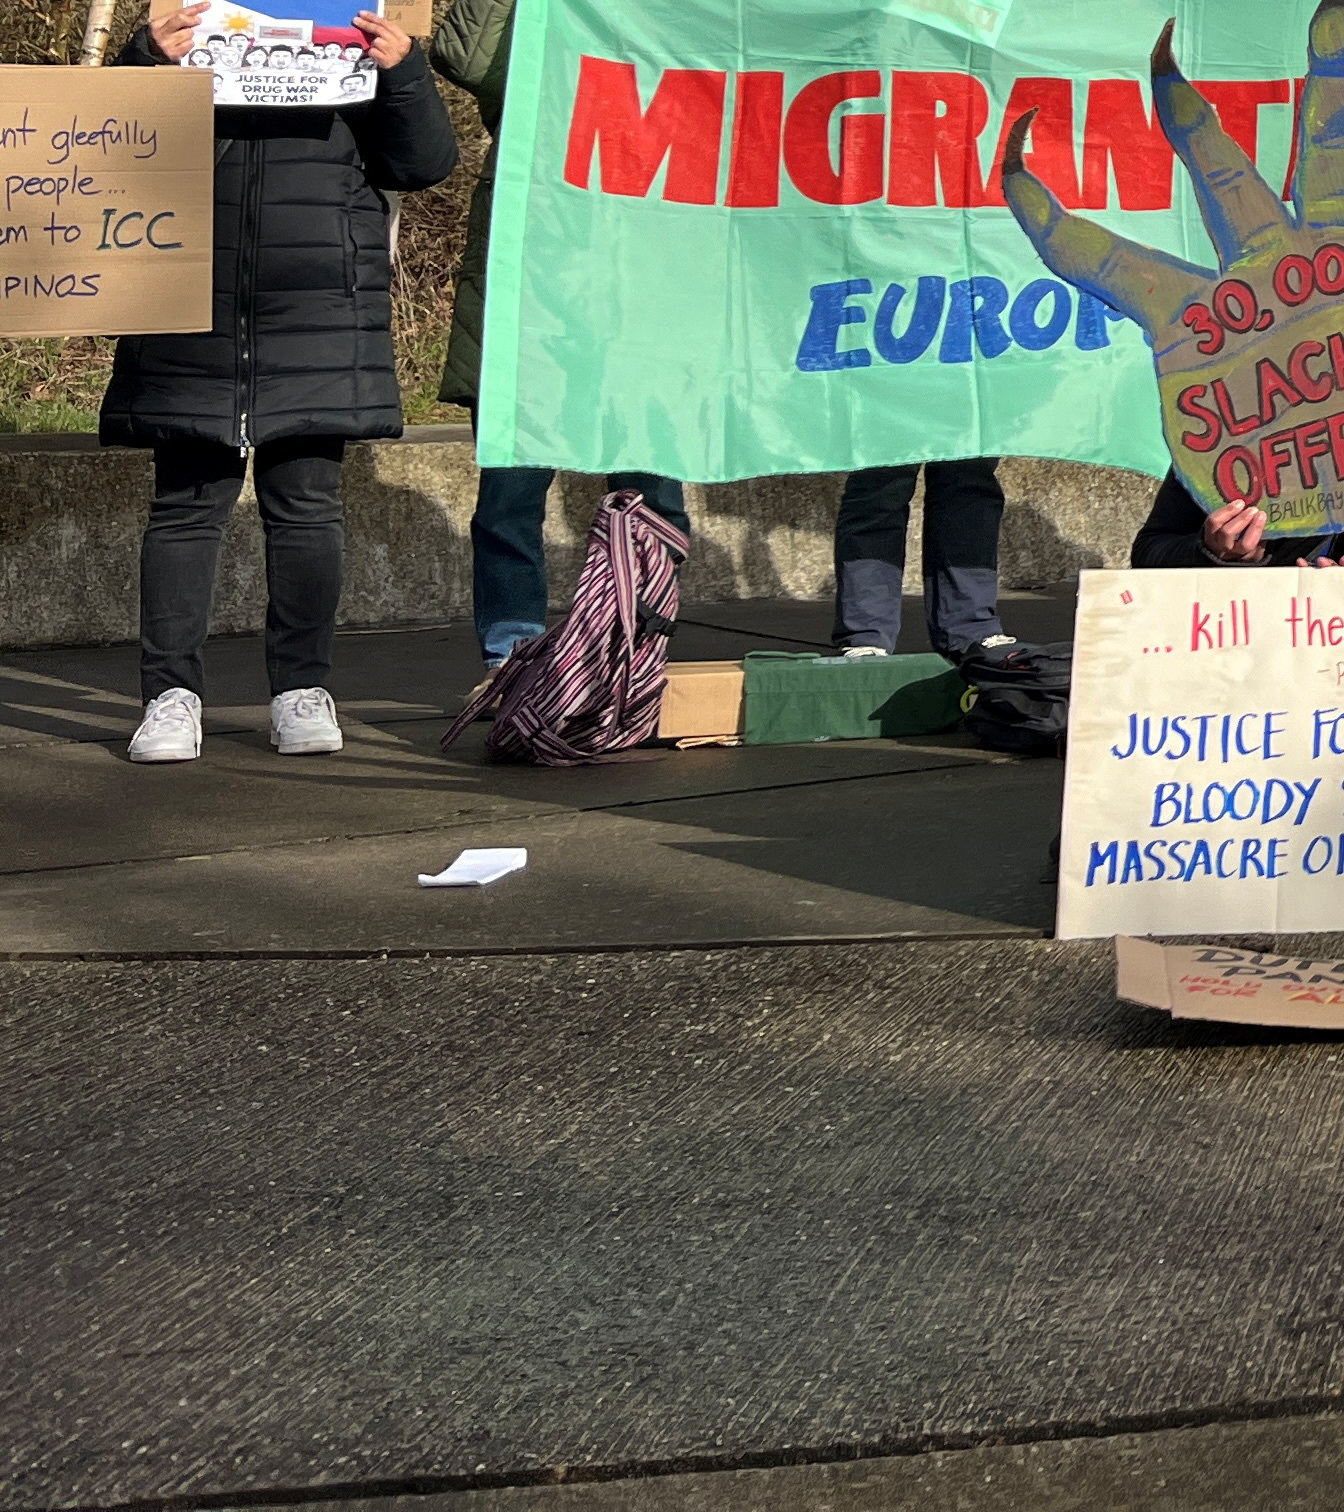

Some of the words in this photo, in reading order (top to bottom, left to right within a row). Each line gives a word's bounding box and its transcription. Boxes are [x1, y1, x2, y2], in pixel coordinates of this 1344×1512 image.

[235, 74, 297, 85] JUSTICE
[300, 74, 328, 85] FOR
[242, 84, 283, 94] DRUG
[286, 85, 319, 94] WAR
[244, 93, 314, 103] VICTIMS!
[47, 114, 157, 164] gleefully
[44, 211, 82, 246] to
[95, 208, 184, 251] ICC
[0, 274, 101, 299] PINOS
[1190, 598, 1250, 653] kill
[1111, 709, 1290, 763] JUSTICE
[1150, 775, 1322, 828] BLOODY
[1085, 837, 1290, 887] MASSACRE
[1179, 974, 1263, 988] HOLD
